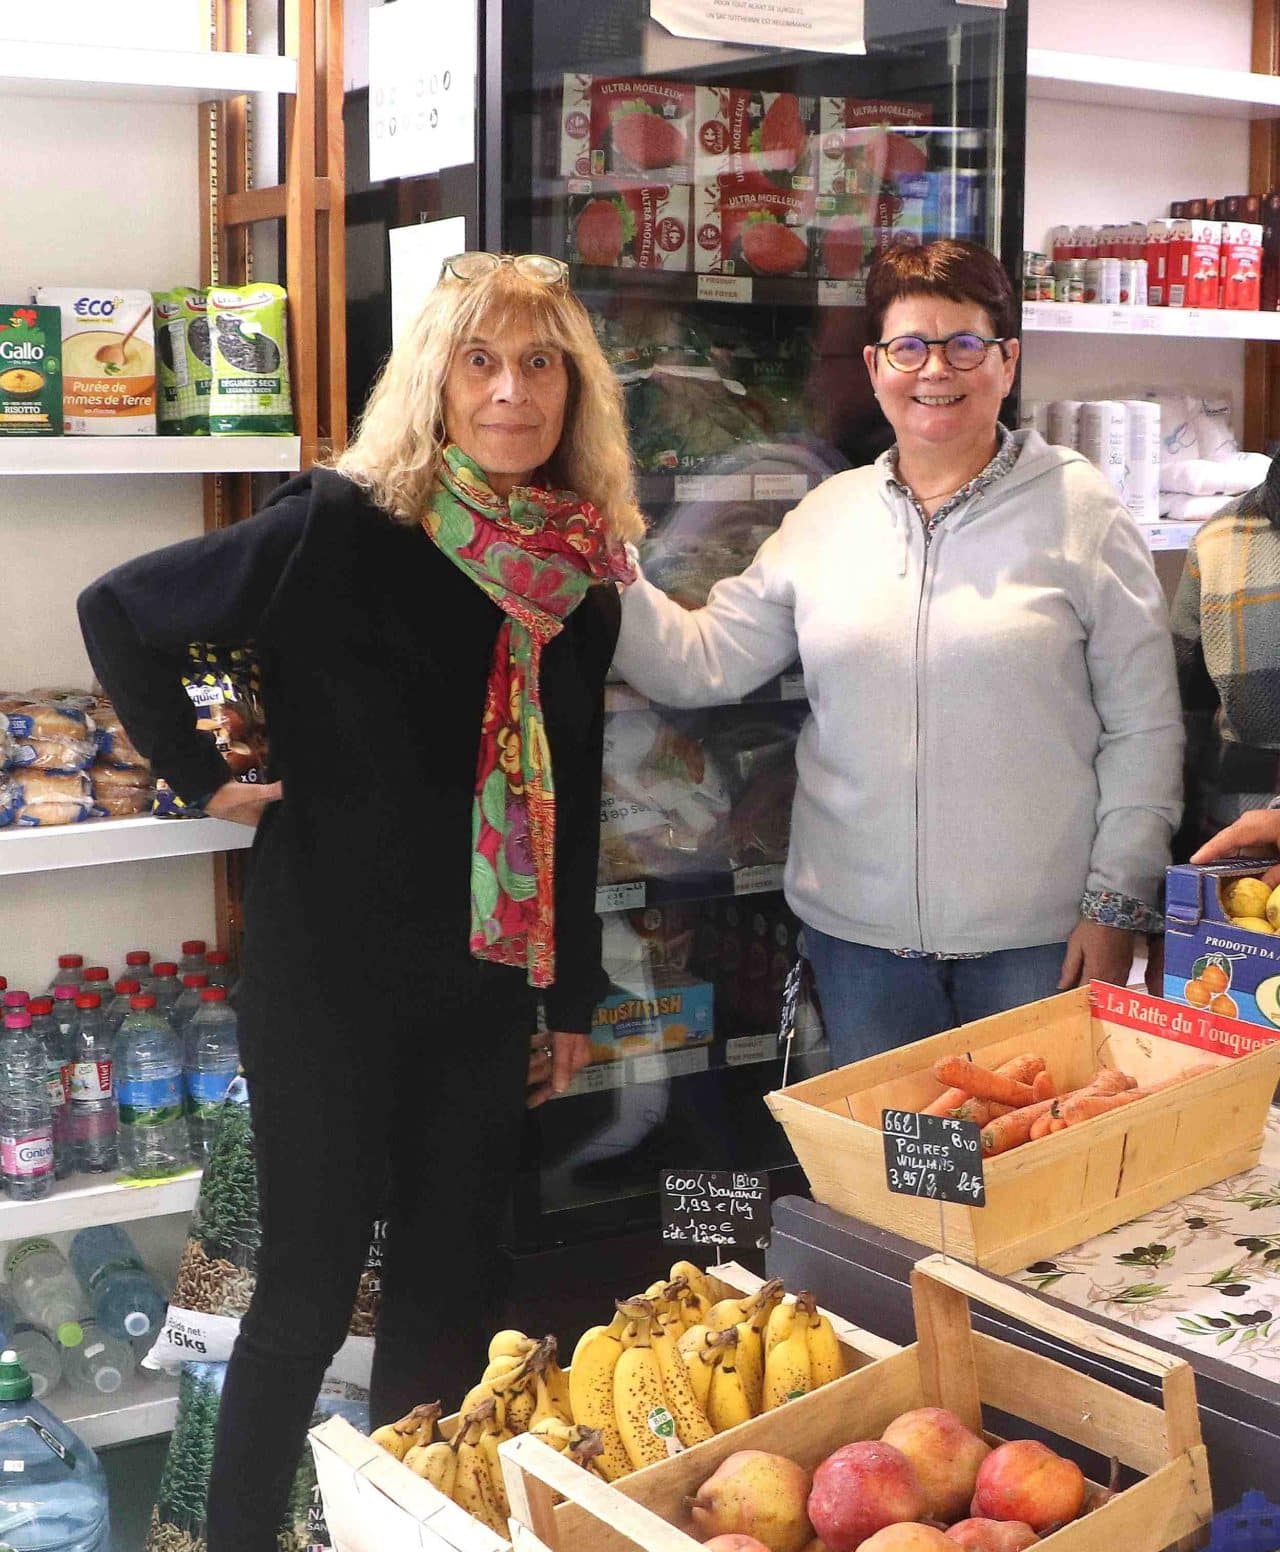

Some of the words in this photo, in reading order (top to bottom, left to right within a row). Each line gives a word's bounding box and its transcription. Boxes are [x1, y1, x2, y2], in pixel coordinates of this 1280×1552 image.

[601, 83, 632, 94] ULTRA
[632, 82, 683, 99] MOELLEUX
[853, 104, 878, 116] ULTRA
[733, 97, 746, 149] MOELLEUX
[641, 187, 651, 221] ULTRA
[729, 193, 757, 207] ULTRA
[0, 341, 44, 360] Gallo
[73, 380, 109, 393] Purée
[111, 381, 127, 393] de
[104, 394, 119, 405] de
[122, 394, 152, 406] Terre
[4, 406, 41, 414] RISOTTO
[241, 768, 257, 782] x6
[1204, 935, 1258, 956] PRODOTTI
[1260, 947, 1275, 959] DA
[1107, 993, 1124, 1014] La
[1128, 999, 1169, 1028] Ratte
[1171, 1012, 1193, 1034] du
[885, 1110, 913, 1133] 662
[896, 1138, 950, 1157] POIRES
[665, 1174, 696, 1191] 600
[673, 1195, 712, 1213] 1,99
[187, 1326, 202, 1337] net
[166, 1328, 207, 1354] 15kg
